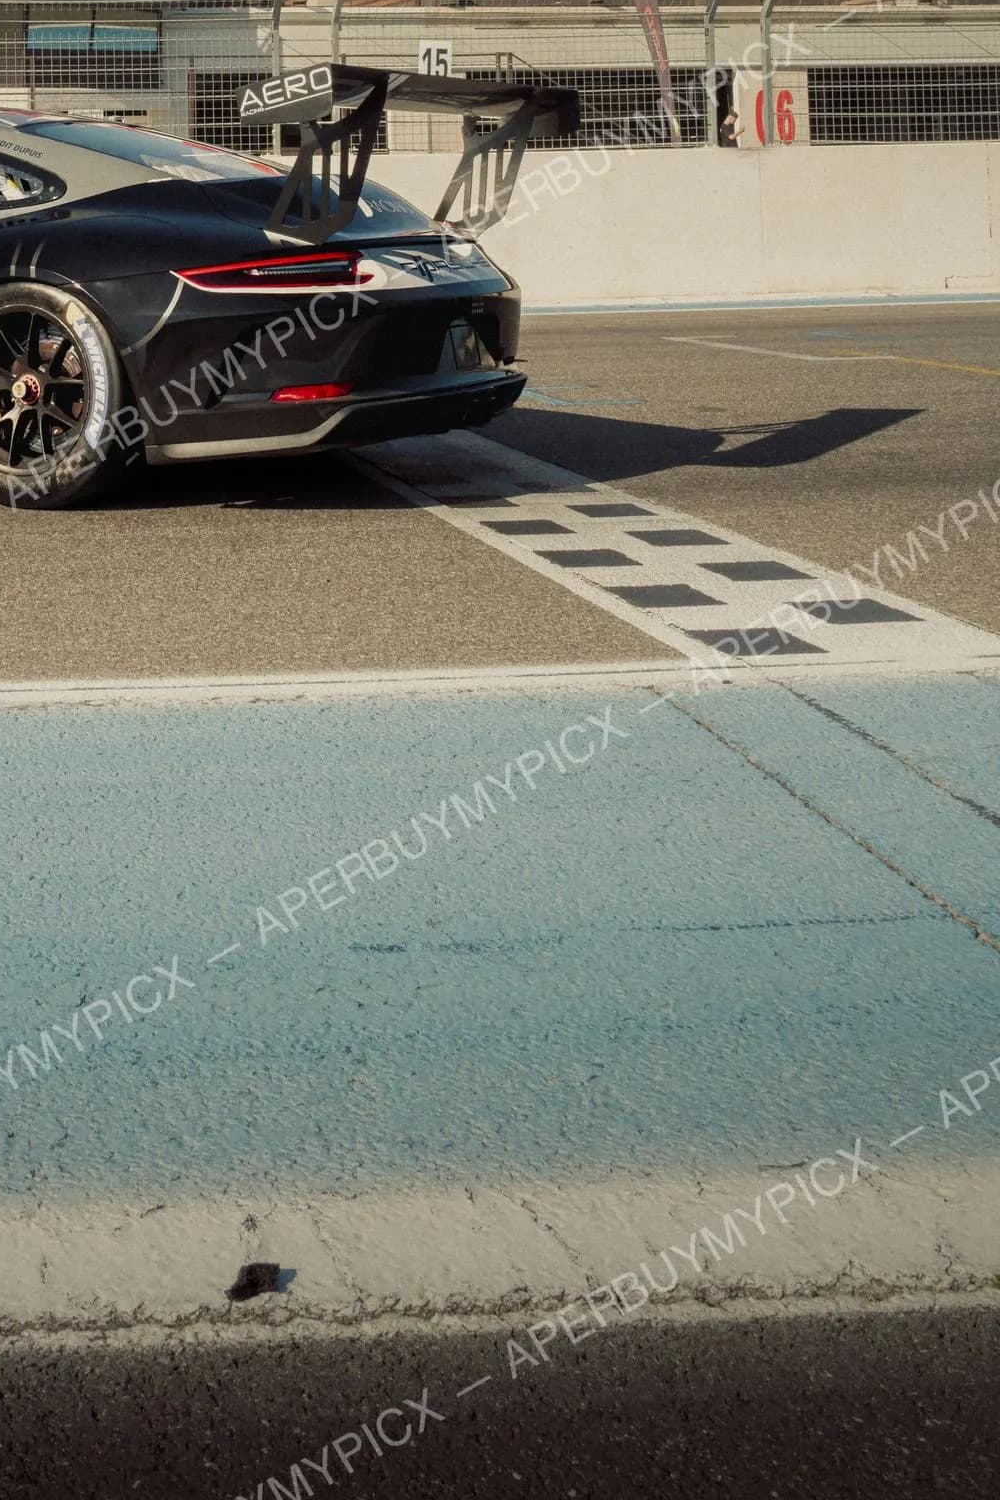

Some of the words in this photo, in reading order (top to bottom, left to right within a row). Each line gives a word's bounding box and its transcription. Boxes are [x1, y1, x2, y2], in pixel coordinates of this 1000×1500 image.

[422, 47, 448, 77] 15
[240, 66, 332, 112] AERO
[13, 144, 43, 159] DUPUIS
[83, 335, 106, 442] MICHELIN
